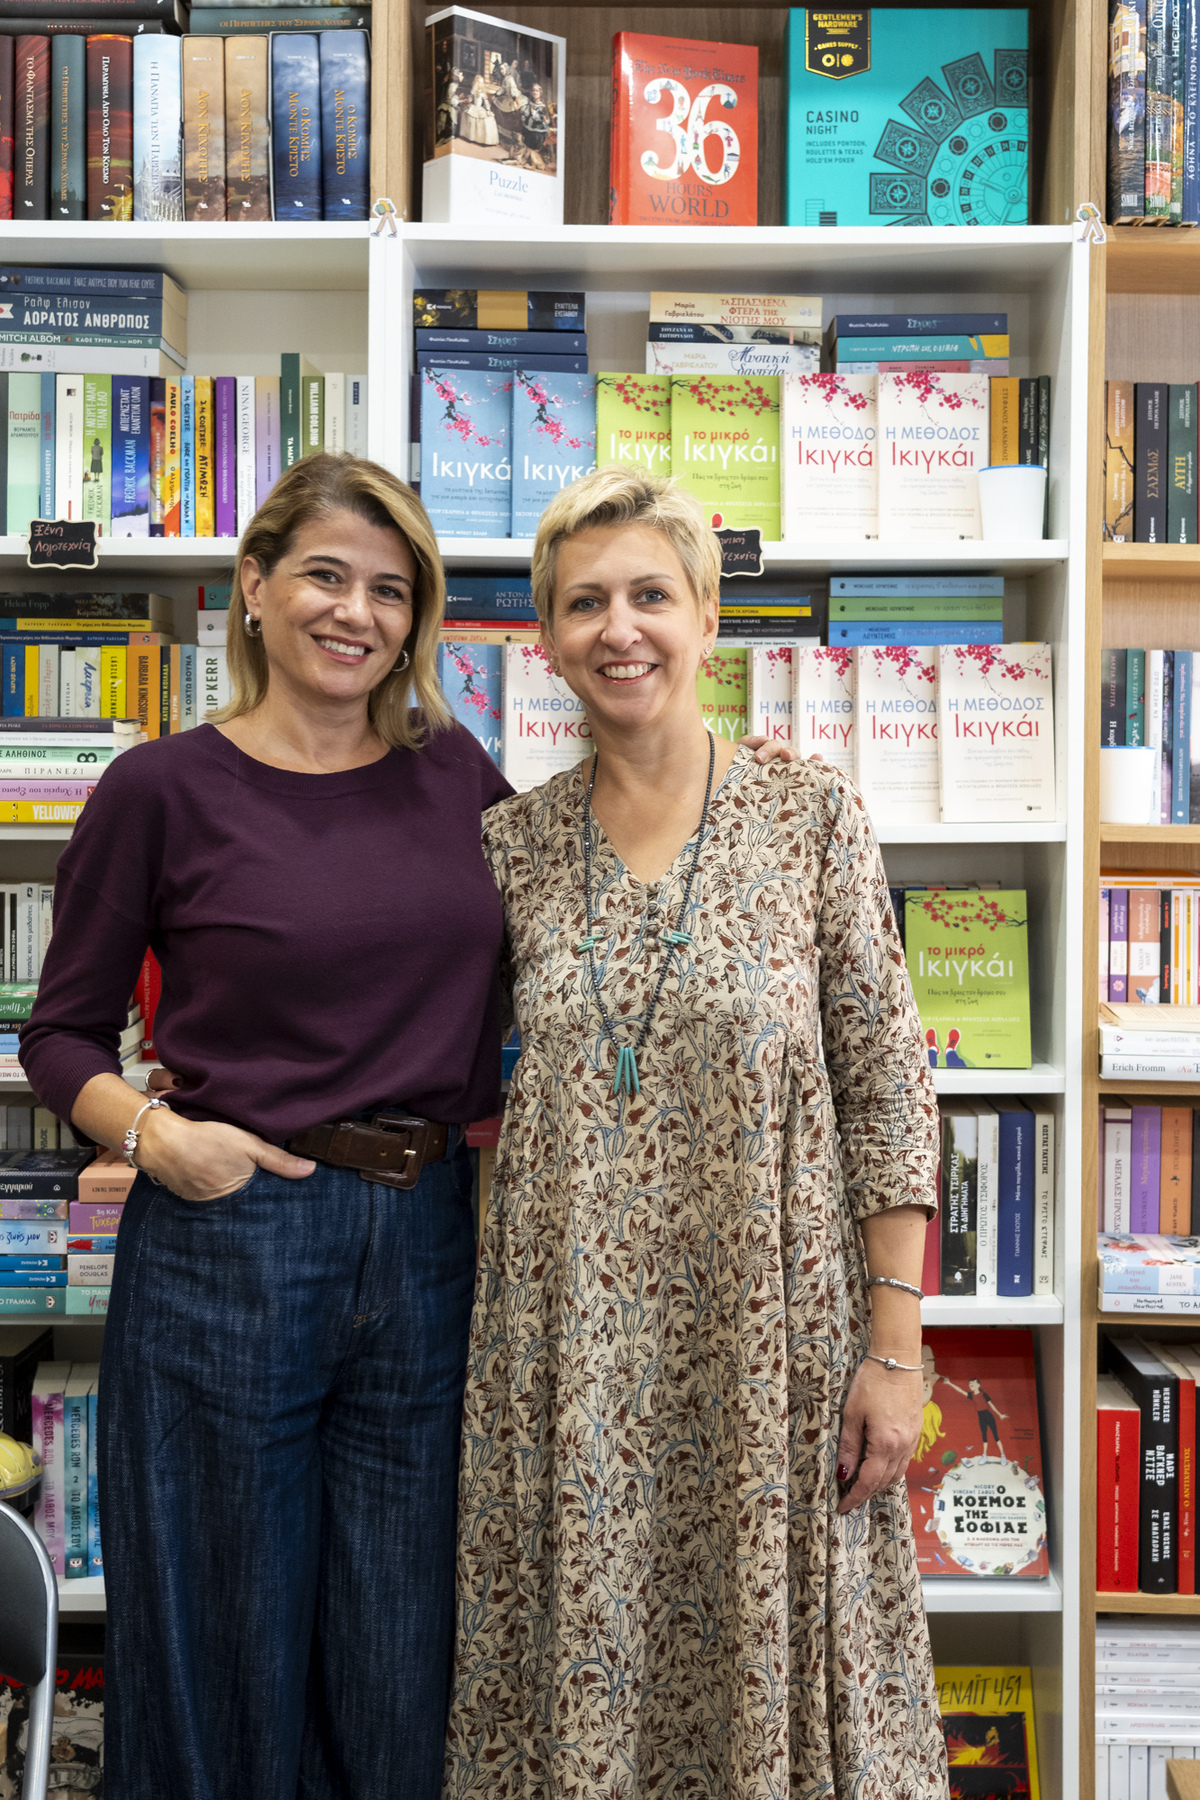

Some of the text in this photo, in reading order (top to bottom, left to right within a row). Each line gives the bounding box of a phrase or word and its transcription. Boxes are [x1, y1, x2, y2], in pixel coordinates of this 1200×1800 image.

[812, 13, 863, 22] GENTLEMEN'S
[817, 20, 858, 28] HARDWARE
[635, 60, 655, 76] The
[683, 65, 711, 82] York
[711, 67, 747, 84] Times
[24, 69, 35, 125] ΦΑΝΤΑΣΜΑ
[102, 100, 110, 118] ΑΠΟ
[806, 110, 860, 124] CASINO
[24, 126, 34, 146] ΤΗΣ
[102, 118, 110, 137] ΟΛΟ
[199, 89, 211, 184] ΔΟΝ ΚΙΧΩΤΗΣ
[241, 89, 252, 182] ΔΟΝ ΚΙΧΩΤΗΣ
[288, 91, 299, 178] ΜΟΝΤΕ ΚΡΙΣΤΟ
[334, 89, 346, 175] ΜΟΝΤΕ ΚΡΙΣΤΟ
[640, 78, 741, 185] 36
[806, 125, 839, 135] NIGHT
[102, 137, 110, 155] ΤΟΝ
[25, 147, 35, 187] ΟΠΕΡΑΣ
[102, 155, 110, 184] ΚΟΣΜΟ
[489, 169, 529, 193] Puzzle
[666, 182, 713, 198] HOURS
[649, 194, 730, 219] WORLD
[24, 296, 51, 310] Ραλφ
[728, 306, 762, 316] ΦΤΕΡΑ
[731, 297, 787, 307] ΣΠΑΣΜΕΝΑ
[23, 311, 150, 329] ΑΟΡΑΤΟΣ ΑΝΘΡΩΠΟΣ
[665, 310, 705, 319] Γαβριελάτου
[720, 315, 787, 325] ΝΙΟΤΗΣ ΜΟΥ
[28, 335, 61, 343] ALBOM
[9, 410, 41, 422] Πατρίδα
[241, 384, 250, 456] NINA GEORGE
[309, 381, 319, 447] WILLIAM GOLDING
[692, 427, 751, 444] το μικρό
[792, 425, 876, 441] Η ΜΕΘΟΔΟ
[886, 426, 981, 441] Η ΜΕΘΟΔΟΣ
[684, 434, 776, 470] Ικιγκάι
[891, 441, 974, 475] Ικιγκάι
[124, 439, 136, 504] FREDRIK BACKMAN
[198, 454, 208, 498] ΑΤΙΜΩΣΗ
[1174, 456, 1186, 490] ΑΥΓΗ
[87, 487, 96, 515] FREDRIK
[95, 484, 104, 518] BACKMAN
[33, 523, 64, 539] Ξένη
[34, 539, 92, 558] Λογοτεχνία
[508, 591, 525, 599] ΤΟΝ
[138, 655, 148, 686] BARBARA
[79, 661, 97, 709] Λατρεία
[185, 706, 192, 716] ΤΑ
[513, 697, 524, 711] Η
[866, 699, 877, 713] Η
[948, 697, 1045, 712] Η ΜΕΘΟΔΟΣ
[955, 713, 1039, 745] Ικιγκάι
[5, 749, 48, 759] ΑΛΗΘΙΝΟΣ
[24, 767, 86, 776] ΠΙΡΑΝΕΖΙ
[43, 785, 74, 798] Χημεία
[75, 788, 83, 796] Η
[26, 904, 34, 934] μαθαίνεις
[28, 934, 33, 944] να
[927, 943, 986, 959] το μικρό
[918, 950, 1014, 985] Ικιγκάι
[1111, 1062, 1166, 1073] Erich Fromm
[950, 1152, 960, 1234] ΣΤΡΑΤΗΣ ΤΣΙΡΚΑΣ
[960, 1180, 969, 1234] ΤΑ ΔΙΗΓΗΜΑΤΑ
[979, 1162, 988, 1247] Ο ΠΡΩΤΟΣ ΤΣΙΦΟΡΟΣ
[1178, 1301, 1191, 1309] ΤΟ
[1152, 1388, 1161, 1422] MÜNKLER
[1162, 1387, 1170, 1423] HERFRIED
[43, 1402, 55, 1466] MERCEDES RON
[70, 1405, 81, 1468] MERCEDES RON
[1145, 1449, 1155, 1481] ΝΙΤΣΕ
[1156, 1444, 1165, 1487] ΒΑΓΚΝΕΡ
[1165, 1453, 1174, 1479] ΜΑΡΞ
[70, 1491, 81, 1502] ΤΟ
[996, 1485, 1006, 1495] Ο
[44, 1480, 55, 1539] ΤΟ ΛΑΘΟΣ ΜΟΥ
[953, 1495, 1026, 1508] ΚΟΣΜΟΣ
[70, 1502, 81, 1530] ΛΑΘΟΣ
[964, 1509, 989, 1519] ΤΗΣ
[954, 1515, 1028, 1534] ΣΟΦΙΑΣ
[70, 1532, 81, 1549] ΣΟΥ
[1151, 1509, 1159, 1563] ΣΕ ΑΝΑΤΑΡΑΧΗ
[1162, 1512, 1170, 1560] ΕΝΑΣ ΚΟΣΜΟΣ
